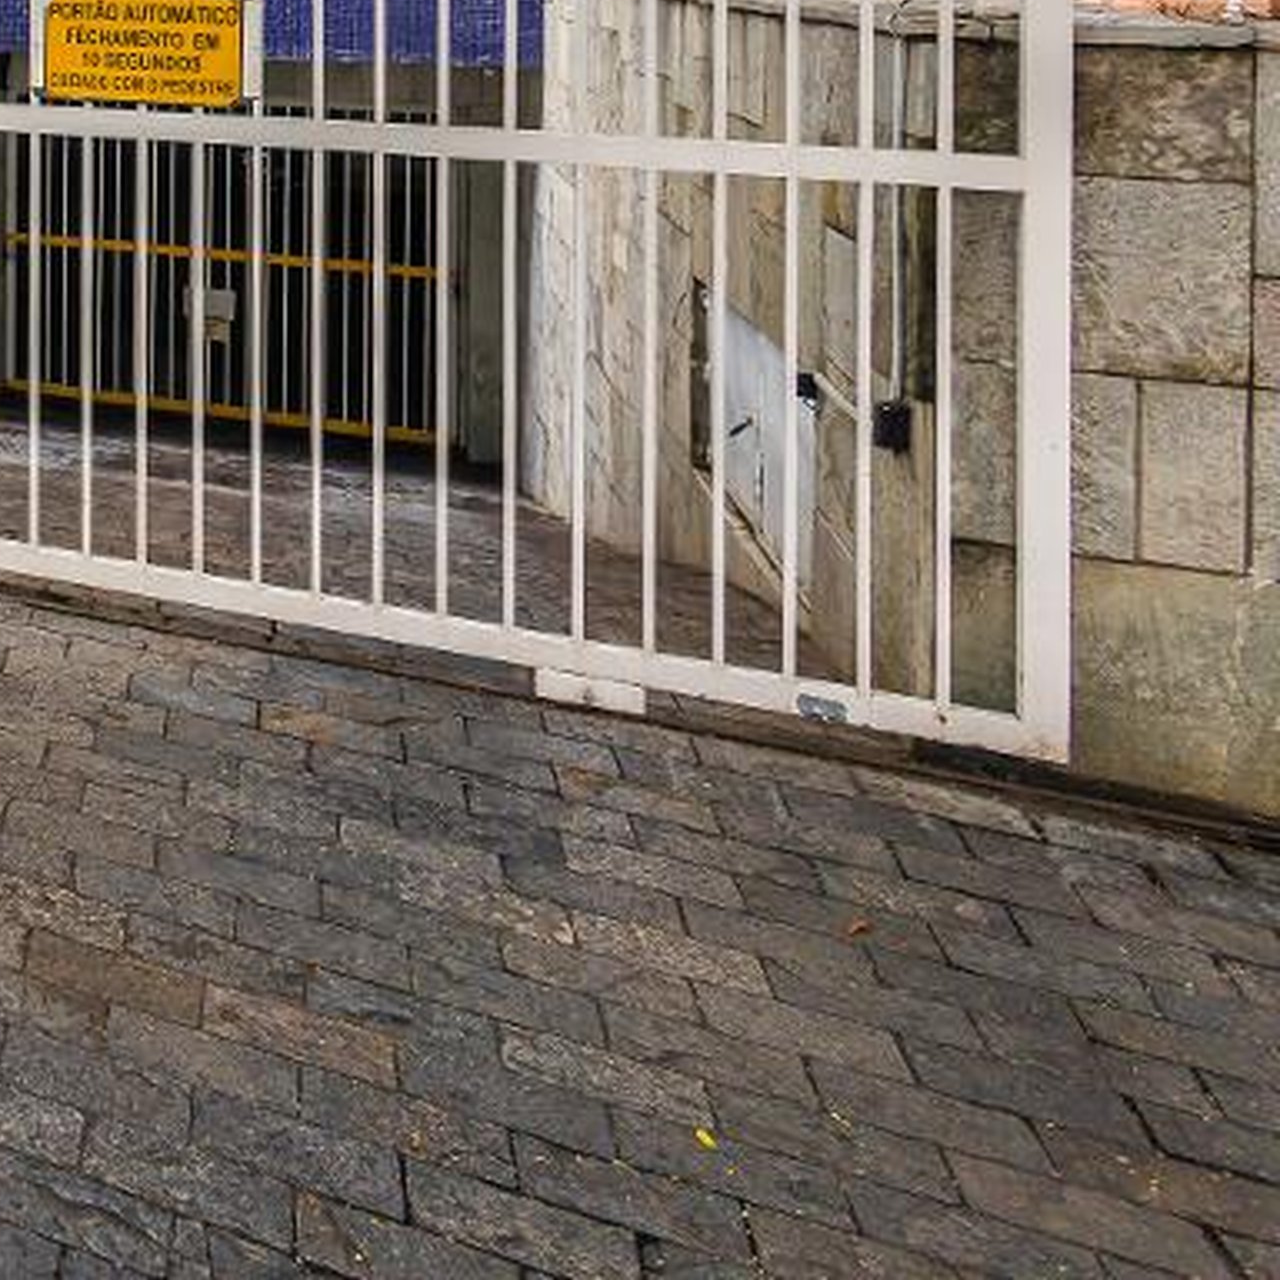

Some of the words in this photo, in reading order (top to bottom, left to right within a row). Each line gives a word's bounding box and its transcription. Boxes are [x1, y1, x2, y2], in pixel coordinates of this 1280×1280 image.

[49, 0, 117, 22] PORTÃO
[123, 2, 238, 26] AUTOMÁTICO
[192, 31, 221, 51] EM
[103, 52, 202, 74] SEGUNDOS
